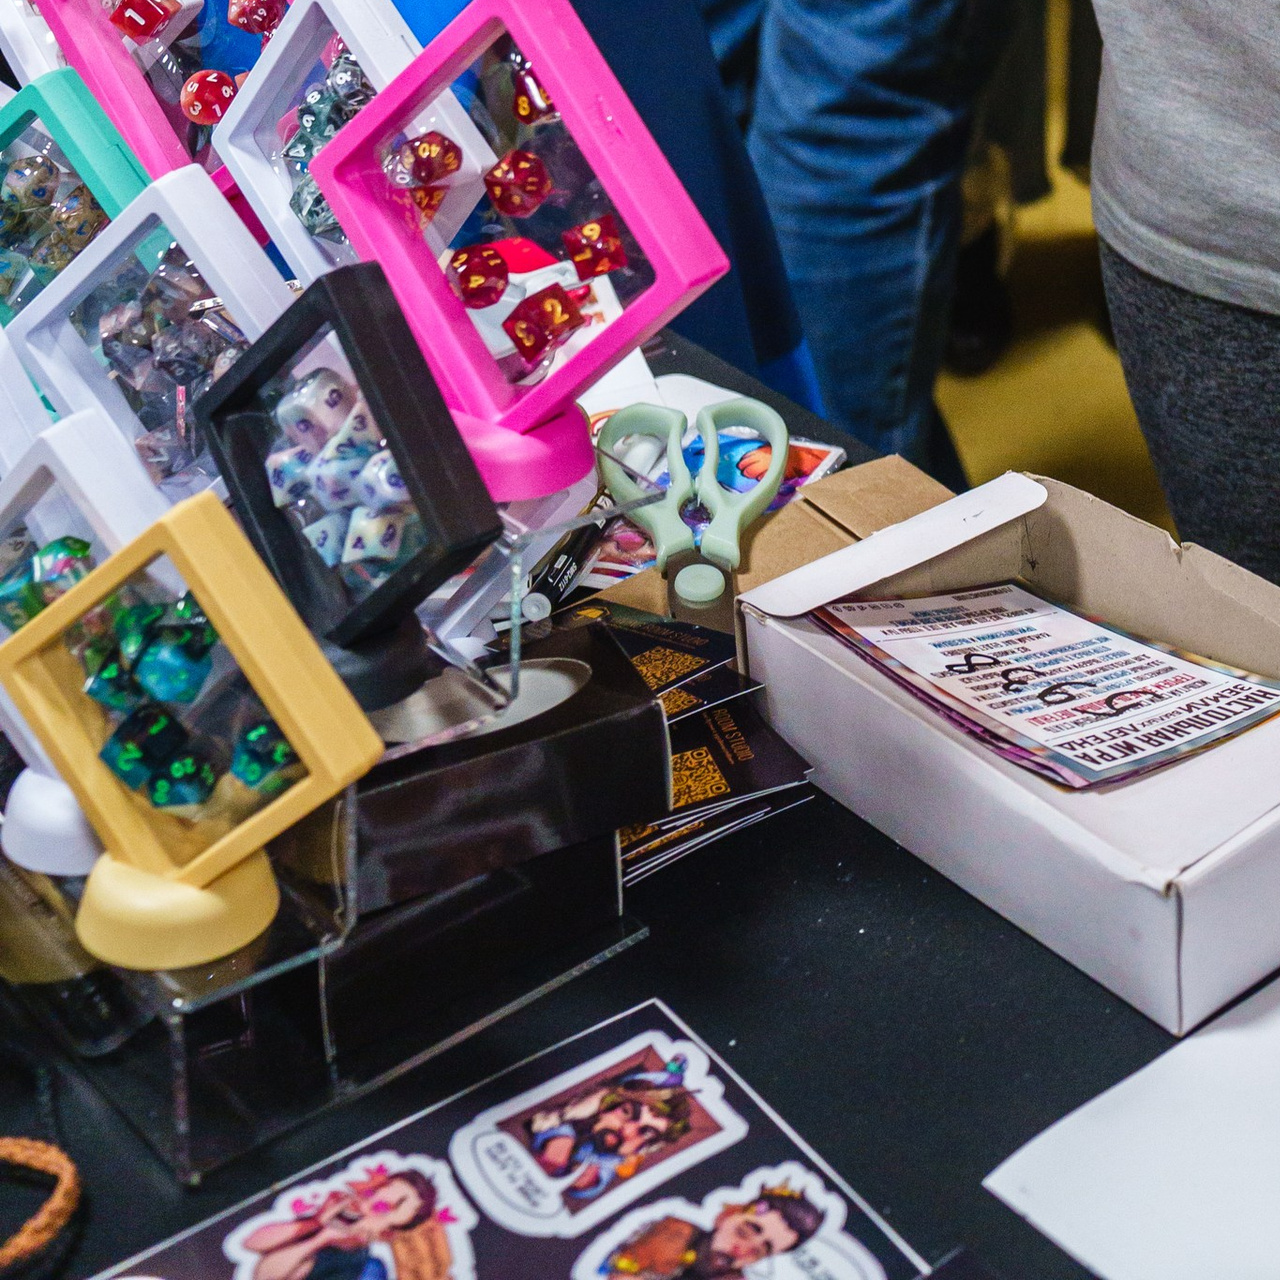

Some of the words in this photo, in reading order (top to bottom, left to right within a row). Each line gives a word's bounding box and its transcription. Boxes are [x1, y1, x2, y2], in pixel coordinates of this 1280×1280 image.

[1173, 683, 1255, 713] ЗЕМЛИ
[1053, 721, 1141, 755] ЛЕГЕНД
[1072, 737, 1145, 770] ИГРА
